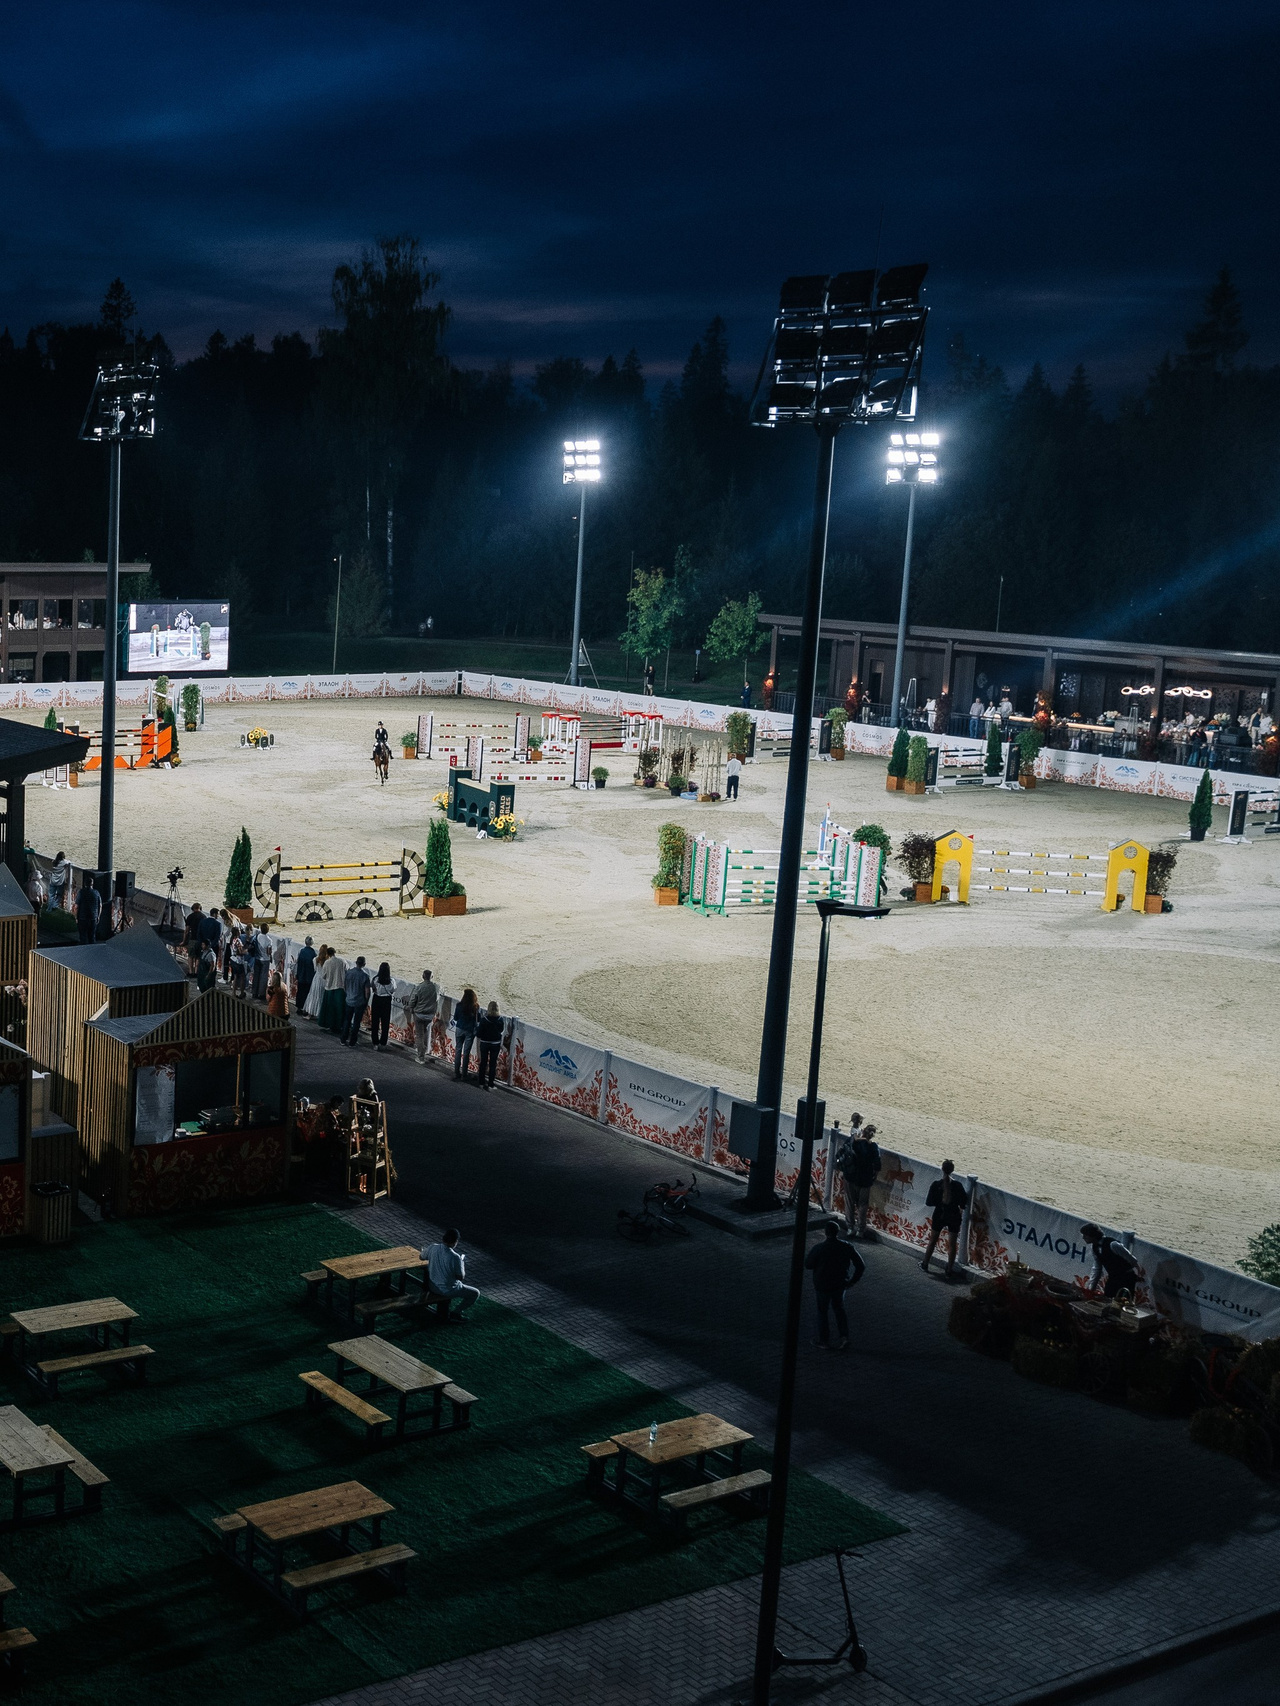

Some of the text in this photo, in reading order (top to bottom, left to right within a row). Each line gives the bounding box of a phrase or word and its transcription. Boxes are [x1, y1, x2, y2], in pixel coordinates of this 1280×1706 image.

[592, 695, 611, 704] ЭТАЛОН
[861, 731, 883, 741] COSMOS
[1178, 774, 1200, 783] СИСТЕМ
[629, 1082, 645, 1094] BN
[647, 1089, 687, 1107] GROUP
[1002, 1218, 1087, 1263] ЭТАЛОН
[1165, 1276, 1191, 1293] BN
[1195, 1288, 1262, 1318] GROUP
